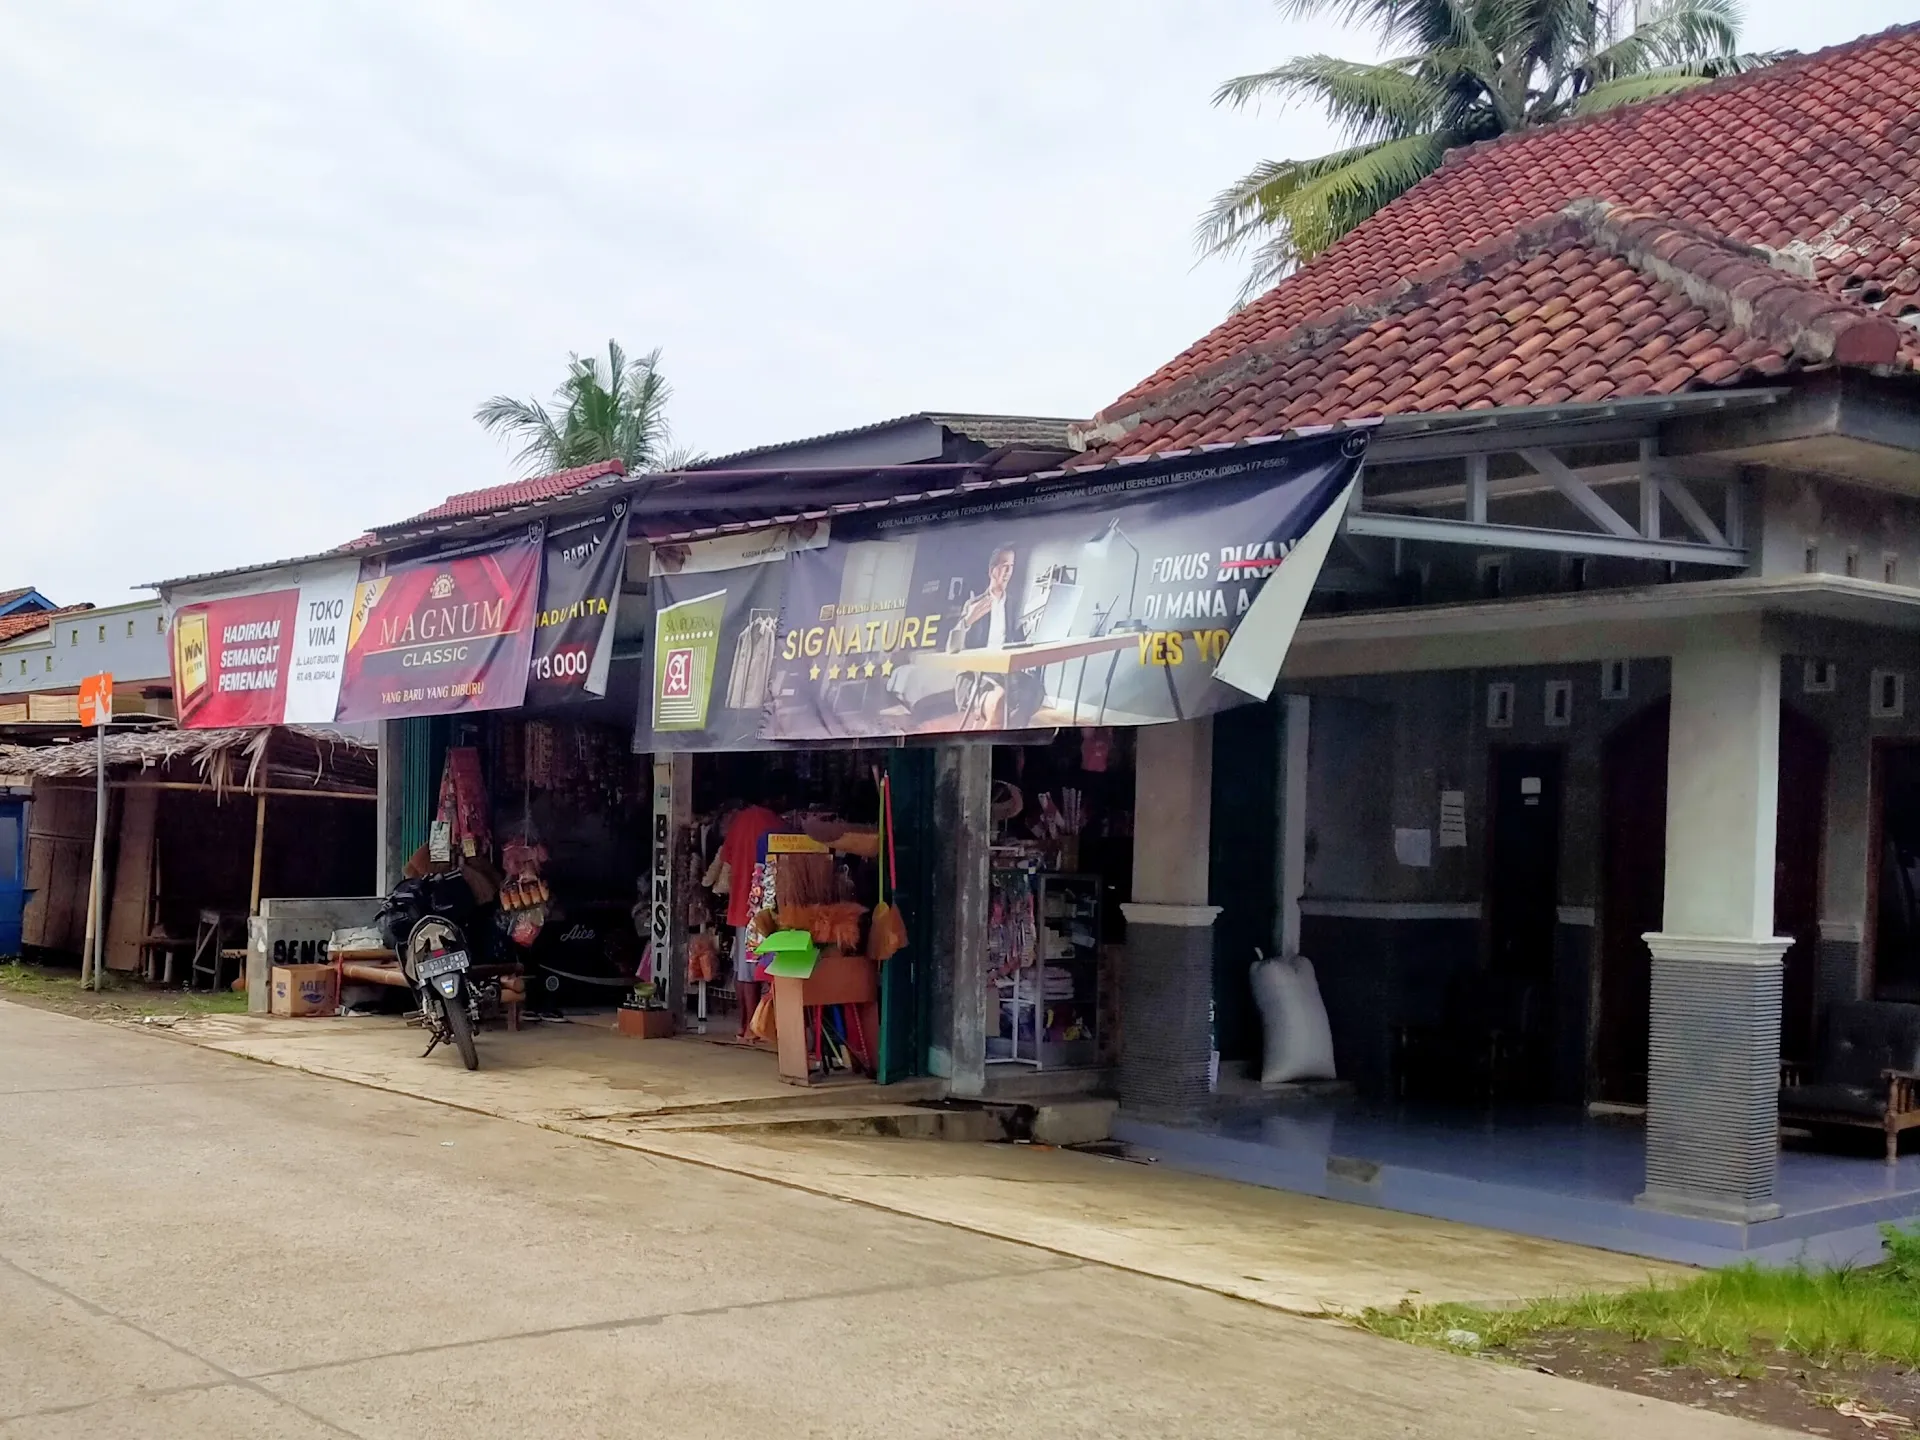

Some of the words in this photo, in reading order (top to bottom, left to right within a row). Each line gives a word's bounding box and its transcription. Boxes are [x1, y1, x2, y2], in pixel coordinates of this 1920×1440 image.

[877, 519, 903, 529] KARENA
[941, 508, 960, 519] SAYA
[960, 503, 993, 516] TERKENA
[994, 498, 1025, 510] KANKER
[1088, 480, 1126, 496] LAYANAN
[1125, 475, 1170, 491] BERHENTI
[1171, 467, 1217, 482] MEROKOK
[563, 543, 596, 564] BARU
[1150, 552, 1210, 584] FOKUS
[309, 598, 344, 622] TOKO
[356, 583, 377, 622] BARU
[1144, 593, 1162, 620] DI
[1164, 589, 1228, 619] MANA
[222, 620, 280, 644] HADIRKAN
[379, 598, 505, 647] MAGNUM
[308, 626, 336, 647] VINA
[782, 614, 942, 661] SIGNATURE
[220, 645, 280, 668] SEMANGAT
[402, 646, 469, 668] CLASSIC
[1138, 630, 1183, 668] YES
[218, 669, 278, 693] PEMENANG
[381, 691, 402, 704] YANG
[403, 688, 425, 702] BARU
[426, 685, 449, 700] YANG
[451, 681, 485, 697] DIBURU
[560, 924, 596, 942] Aice
